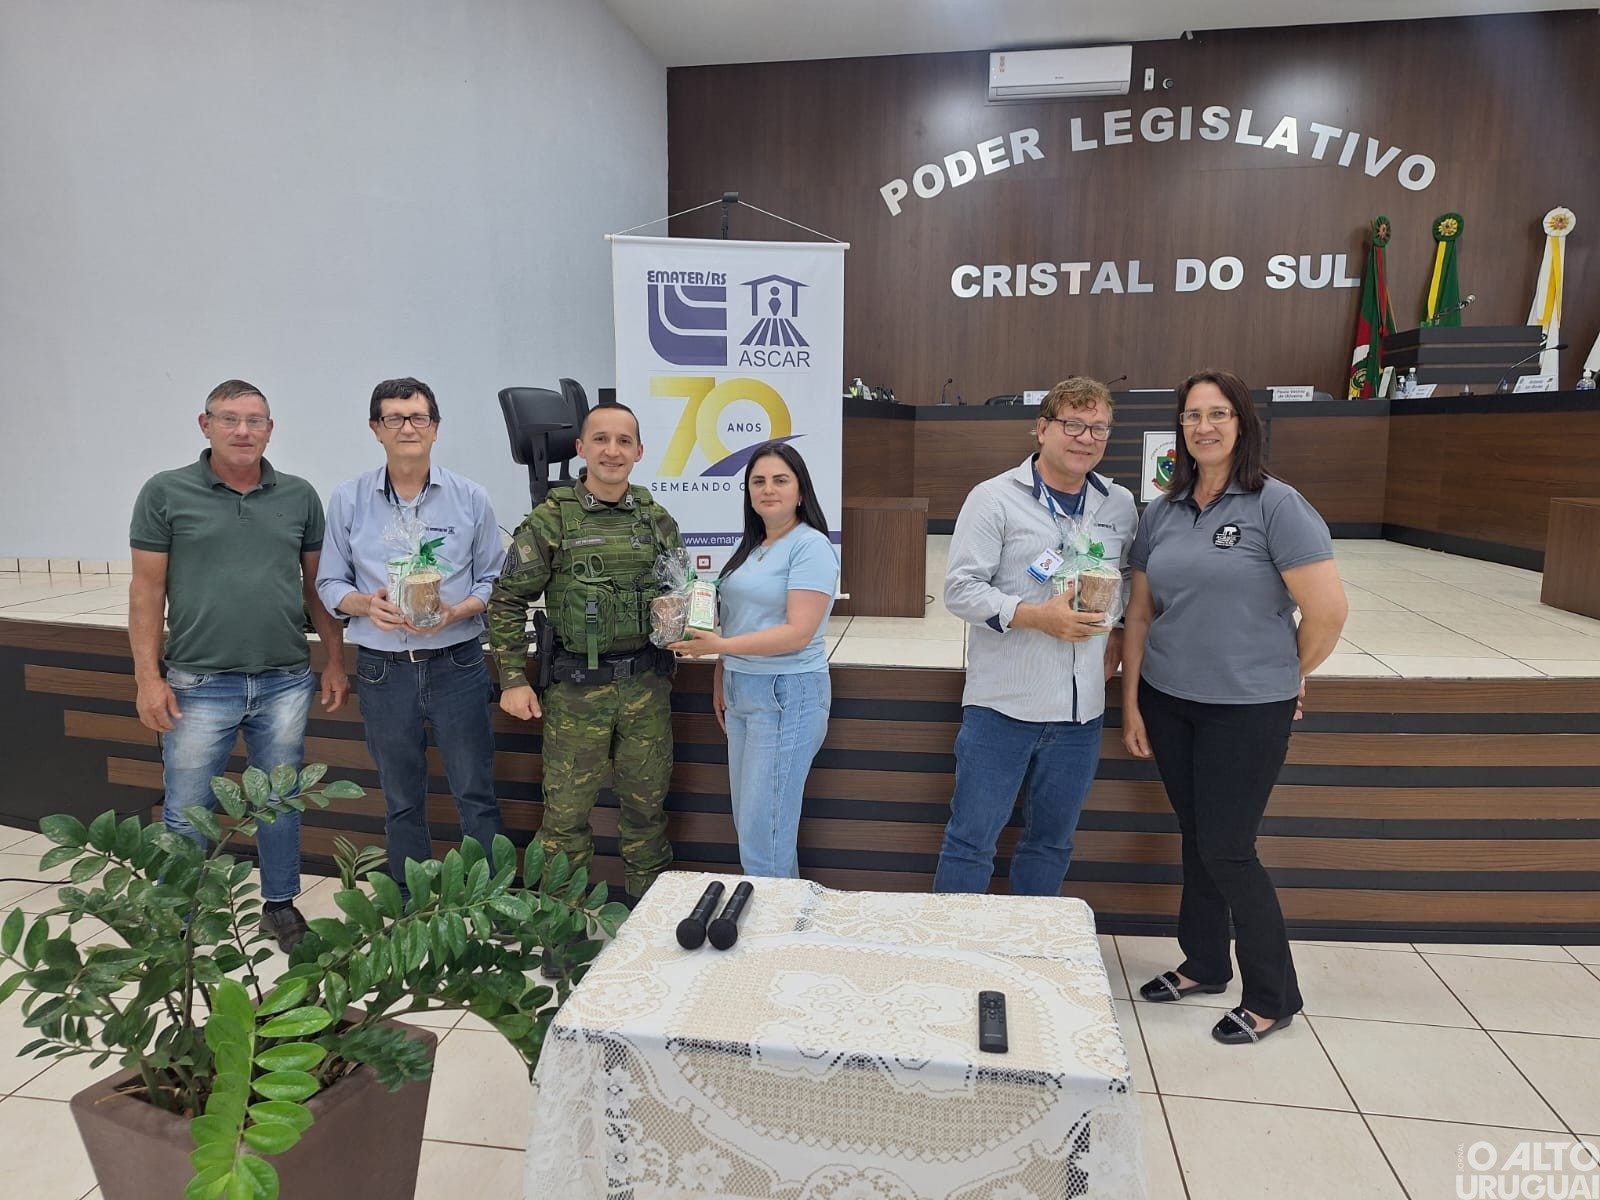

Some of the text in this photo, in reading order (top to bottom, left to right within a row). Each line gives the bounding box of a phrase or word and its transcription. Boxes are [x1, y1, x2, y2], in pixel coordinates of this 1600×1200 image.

[879, 105, 1437, 216] PODER LEGISLATIVO
[647, 270, 728, 286] EMATER/RS
[950, 253, 1361, 299] CRISTAL DO SUL
[738, 350, 811, 368] ASCAR
[649, 376, 792, 477] 70
[727, 422, 762, 433] ANOS
[651, 482, 731, 492] SEMEANDO
[684, 535, 743, 545] www.emate
